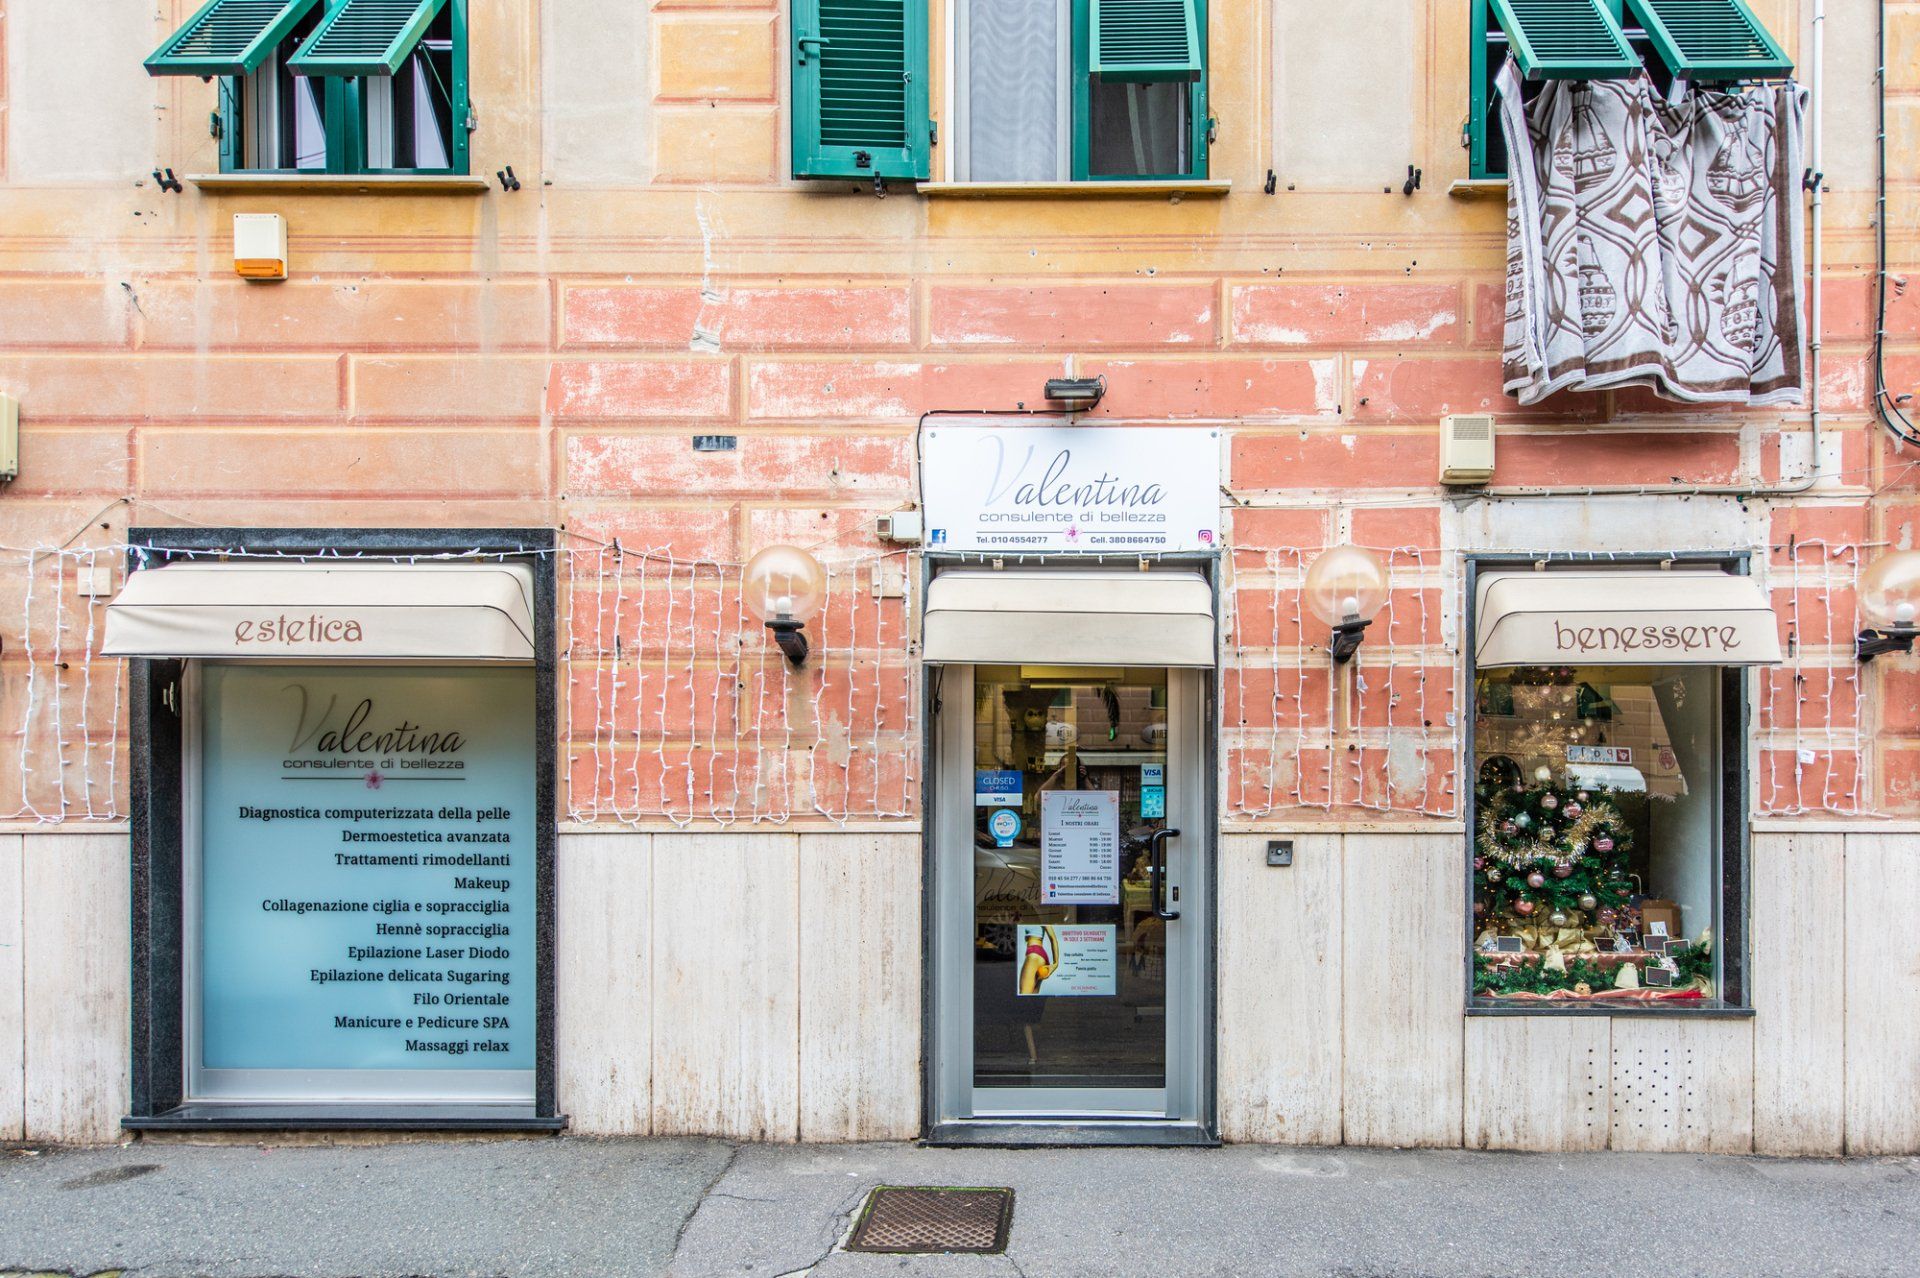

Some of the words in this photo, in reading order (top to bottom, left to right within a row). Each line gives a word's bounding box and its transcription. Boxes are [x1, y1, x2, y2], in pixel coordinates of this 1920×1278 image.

[978, 435, 1168, 507] Valentina
[979, 511, 1073, 522] consulente
[1080, 512, 1093, 521] di
[1101, 511, 1165, 522] bellezza
[1091, 536, 1108, 544] Cell.
[235, 614, 362, 645] estetica
[1554, 619, 1740, 652] benessere
[282, 684, 465, 755] Valentina
[282, 759, 374, 769] consulente
[381, 759, 394, 769] di
[400, 759, 464, 769] bellezza
[1144, 768, 1161, 777] VISA
[983, 777, 1015, 785] CLOSED
[240, 806, 320, 821] Diagnostica
[325, 807, 433, 822] computerizzata
[439, 807, 472, 819] della
[476, 807, 510, 822] pelle
[342, 830, 442, 842] Dermoestetica
[447, 832, 510, 842] avanzata
[335, 854, 418, 865] Trattamenti
[423, 854, 510, 866] rimodellanti
[455, 877, 510, 892] Makeup
[263, 899, 368, 914] Collagenazione
[373, 900, 410, 915] ciglia
[415, 903, 422, 911] e
[426, 900, 509, 915] sopracciglia
[377, 923, 422, 935] Hennè
[426, 924, 509, 938] sopracciglia
[349, 946, 421, 961] Epilazione
[426, 947, 464, 958] Laser
[469, 947, 509, 958] Diodo
[311, 969, 383, 984] Epilazione
[388, 970, 442, 981] delicata
[448, 970, 510, 985] Sugaring
[414, 993, 439, 1004] Filo
[444, 993, 509, 1005] Orientale
[335, 1016, 401, 1028] Manicure
[406, 1019, 413, 1028] e
[418, 1016, 479, 1028] Pedicure
[483, 1017, 509, 1028] SPA
[406, 1040, 469, 1054] Massaggi
[473, 1040, 509, 1051] relax
